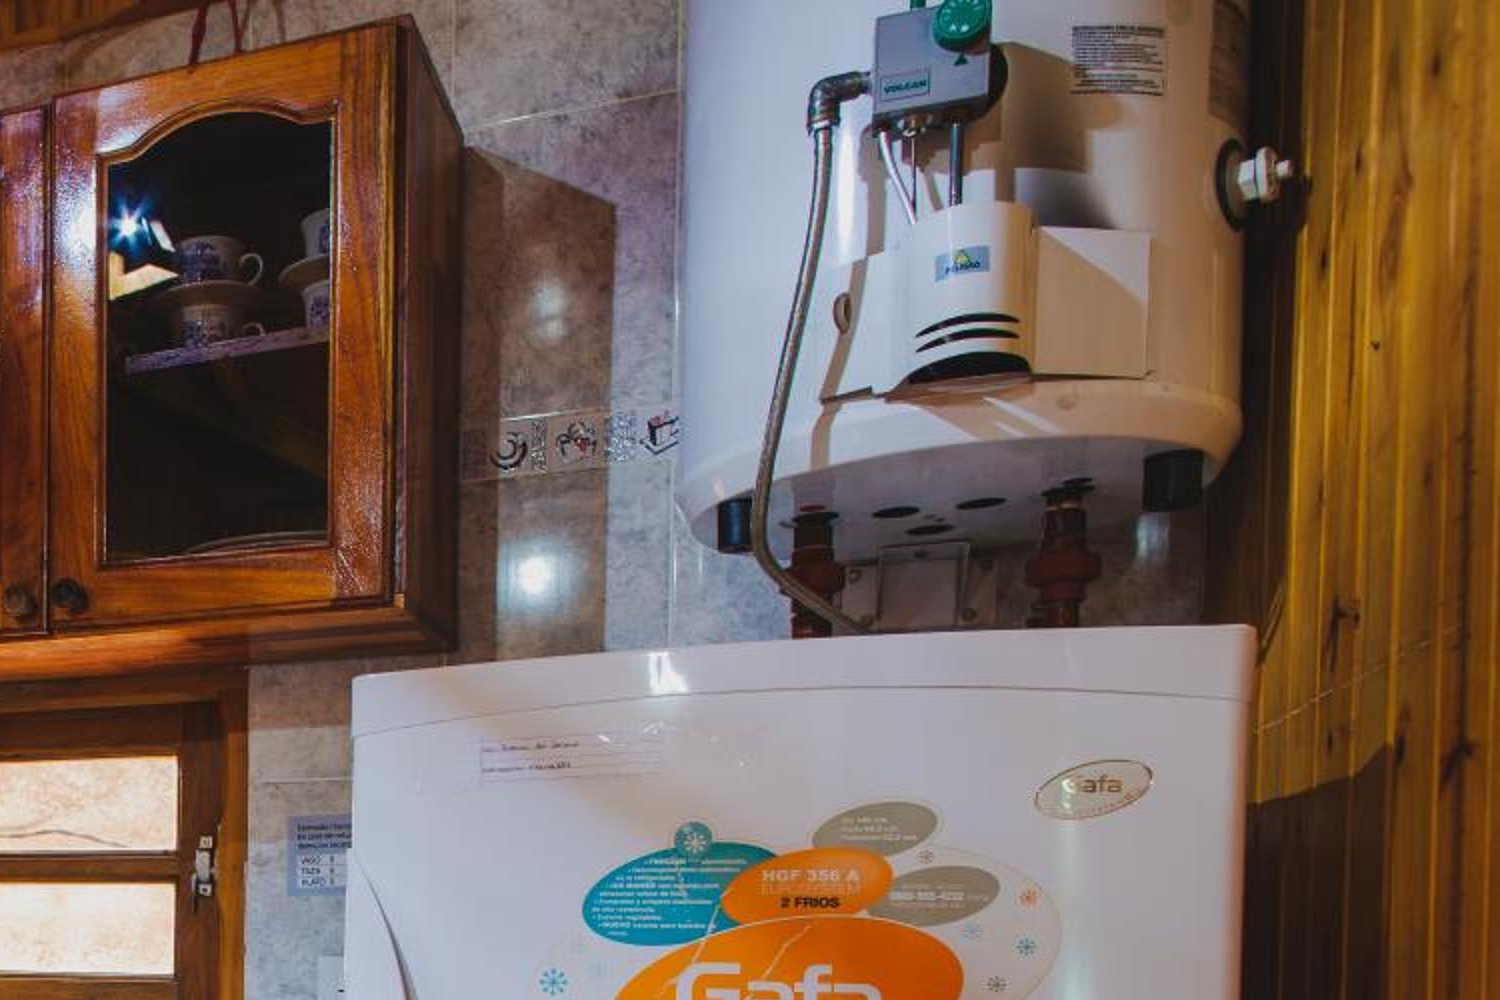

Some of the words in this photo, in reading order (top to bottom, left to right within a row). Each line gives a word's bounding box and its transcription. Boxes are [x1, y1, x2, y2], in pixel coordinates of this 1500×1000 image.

[884, 80, 926, 95] VOLCAN
[844, 868, 861, 881] A
[780, 897, 790, 908] 2
[794, 897, 840, 909] FRIOS
